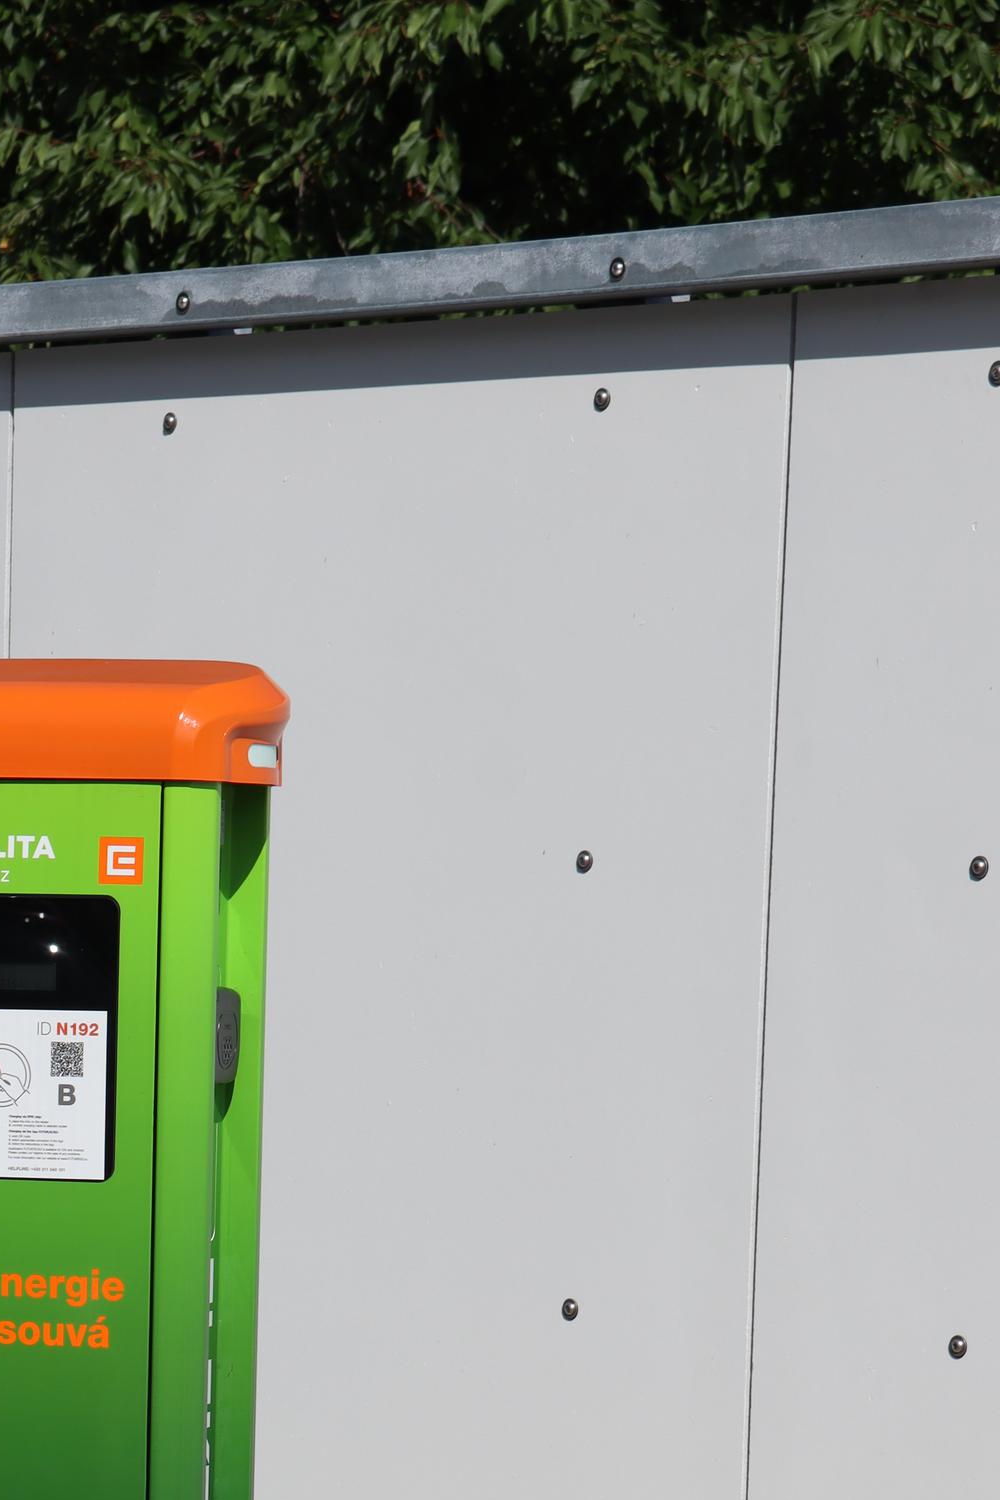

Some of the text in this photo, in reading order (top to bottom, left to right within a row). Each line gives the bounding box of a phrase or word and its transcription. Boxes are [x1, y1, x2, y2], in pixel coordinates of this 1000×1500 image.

[37, 1021, 99, 1036] ID N192
[57, 1083, 76, 1106] B
